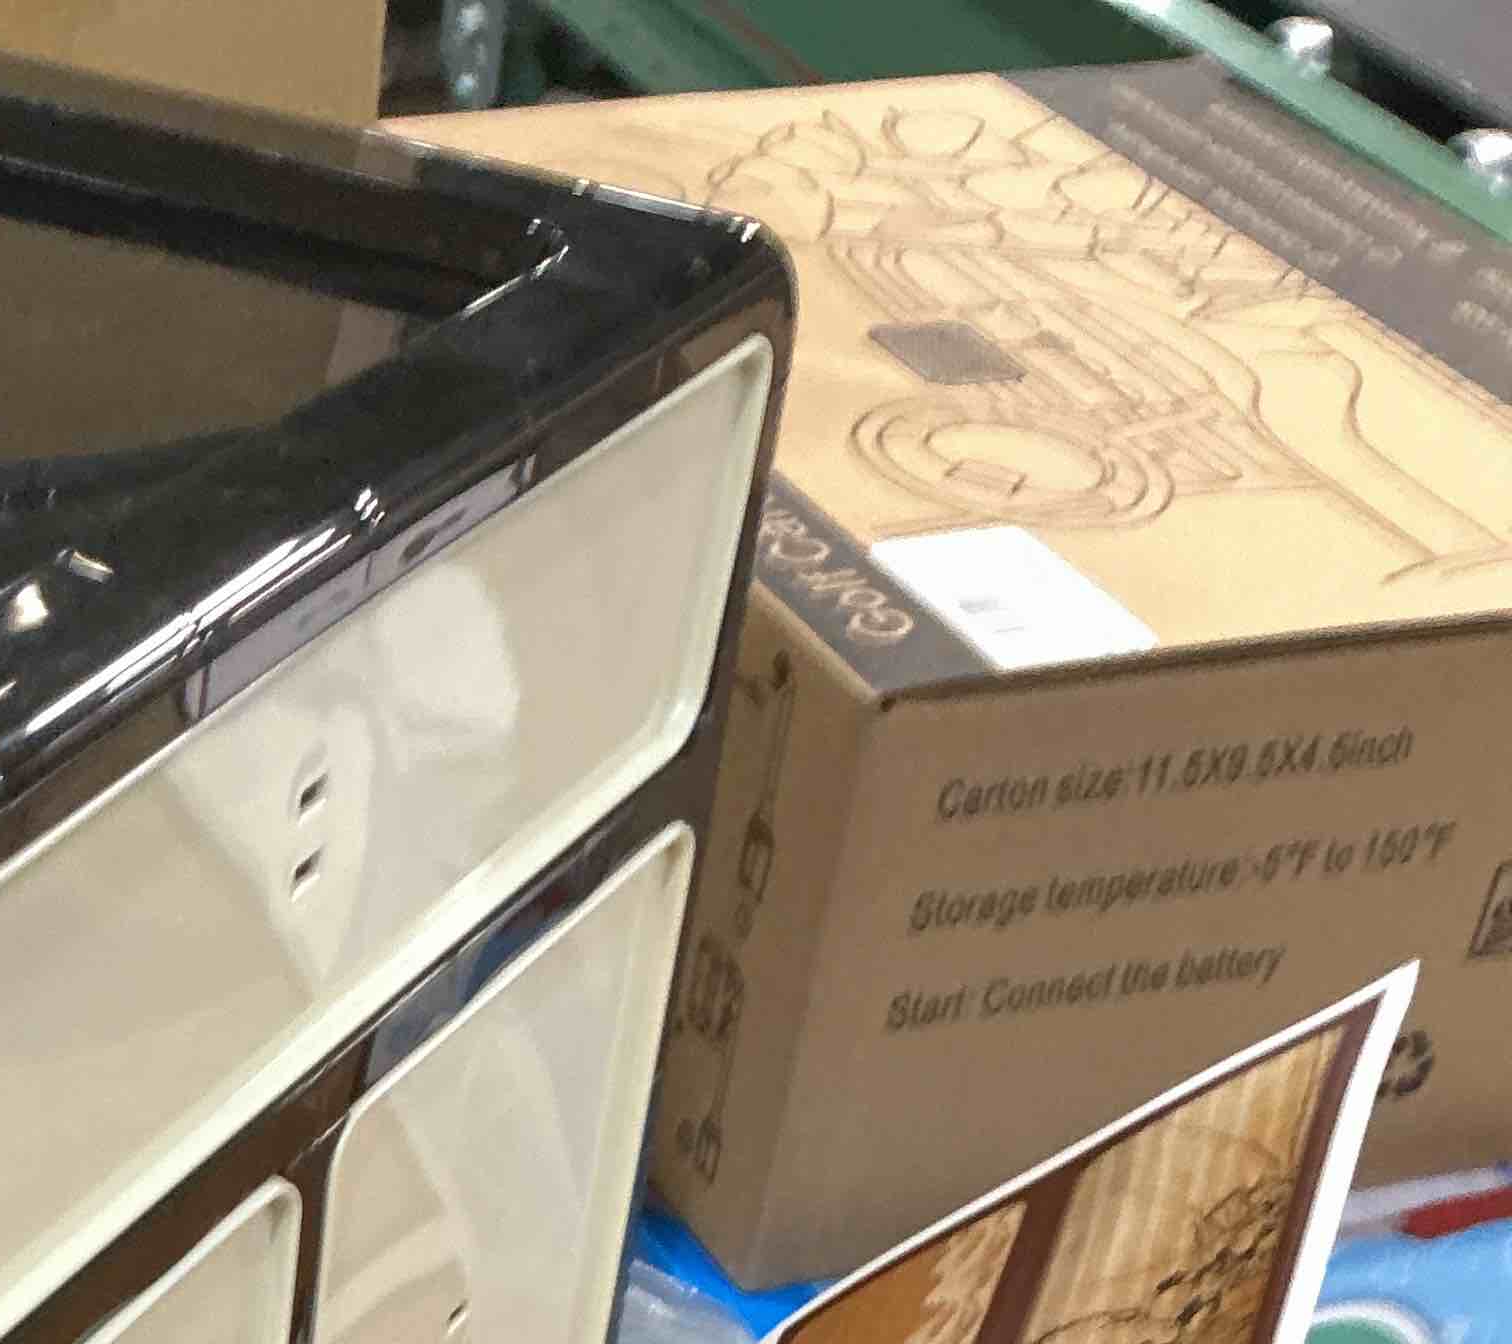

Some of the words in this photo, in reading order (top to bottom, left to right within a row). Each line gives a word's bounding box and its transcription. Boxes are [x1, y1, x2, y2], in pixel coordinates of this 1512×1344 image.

[935, 774, 1050, 822] Carton
[908, 885, 1039, 935] Storage
[1323, 836, 1355, 874] to
[979, 961, 1117, 1020] Connect
[1119, 958, 1170, 999] the
[1173, 943, 1287, 993] battery
